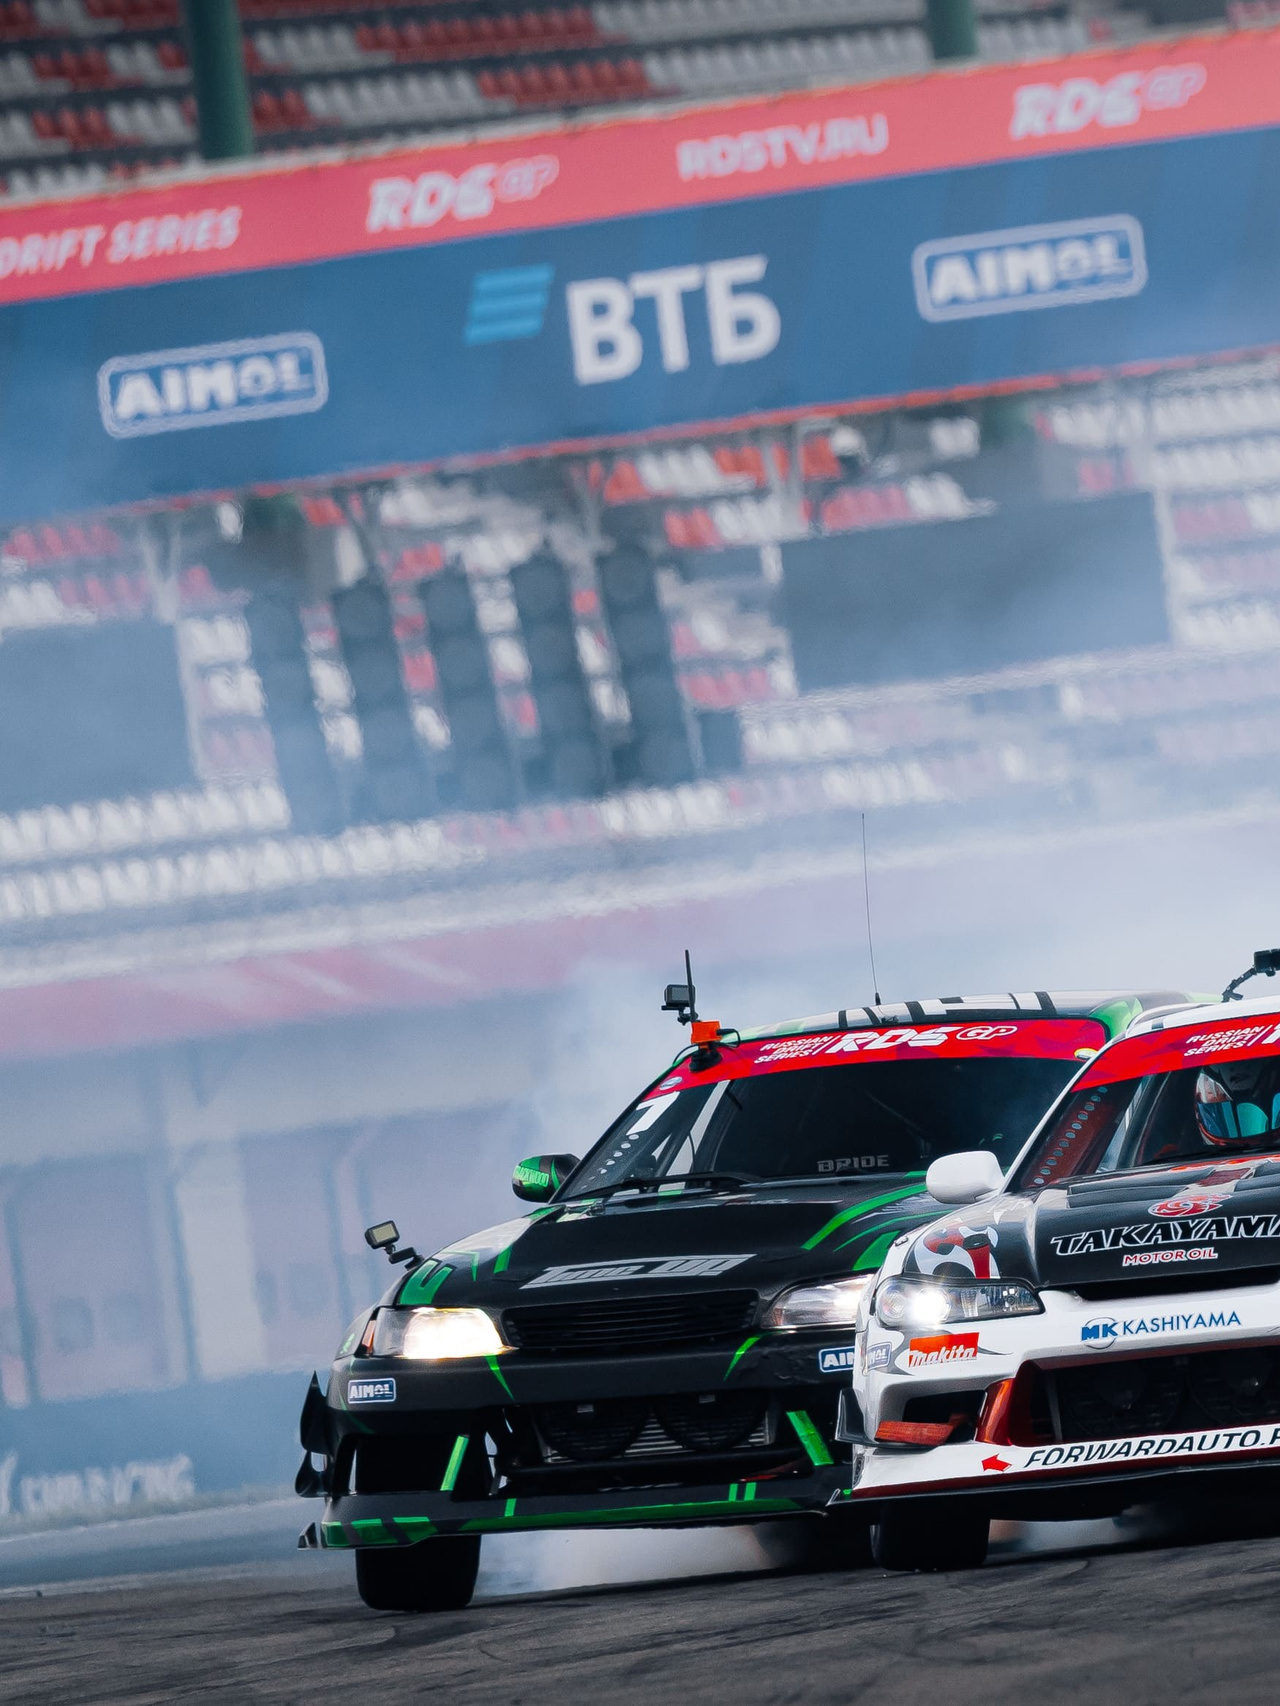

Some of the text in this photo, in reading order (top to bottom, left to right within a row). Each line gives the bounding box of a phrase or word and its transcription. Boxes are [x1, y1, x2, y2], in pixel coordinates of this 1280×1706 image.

[1010, 71, 1142, 141] RDS
[676, 113, 889, 181] RDSTV.RU
[366, 163, 499, 233] RDS
[0, 206, 243, 279] DRIFT SERIES
[926, 234, 1134, 306] AIMOL
[566, 254, 783, 386] ВТБ
[112, 350, 313, 421] AIMOL
[759, 1035, 835, 1052] RUSSIAN
[825, 1025, 1018, 1054] RDS GP
[1185, 1025, 1265, 1044] RUSSIAN
[1201, 1032, 1260, 1048] DRIFT
[753, 1049, 813, 1064] SERIES
[773, 1042, 827, 1055] DRIFT
[1183, 1040, 1247, 1057] SERIES
[816, 1154, 889, 1173] BRIDE
[1122, 1247, 1218, 1267] MOTOR OIL
[1081, 1311, 1241, 1341] MK KASHIYAMA
[349, 1384, 393, 1399] AIMOL
